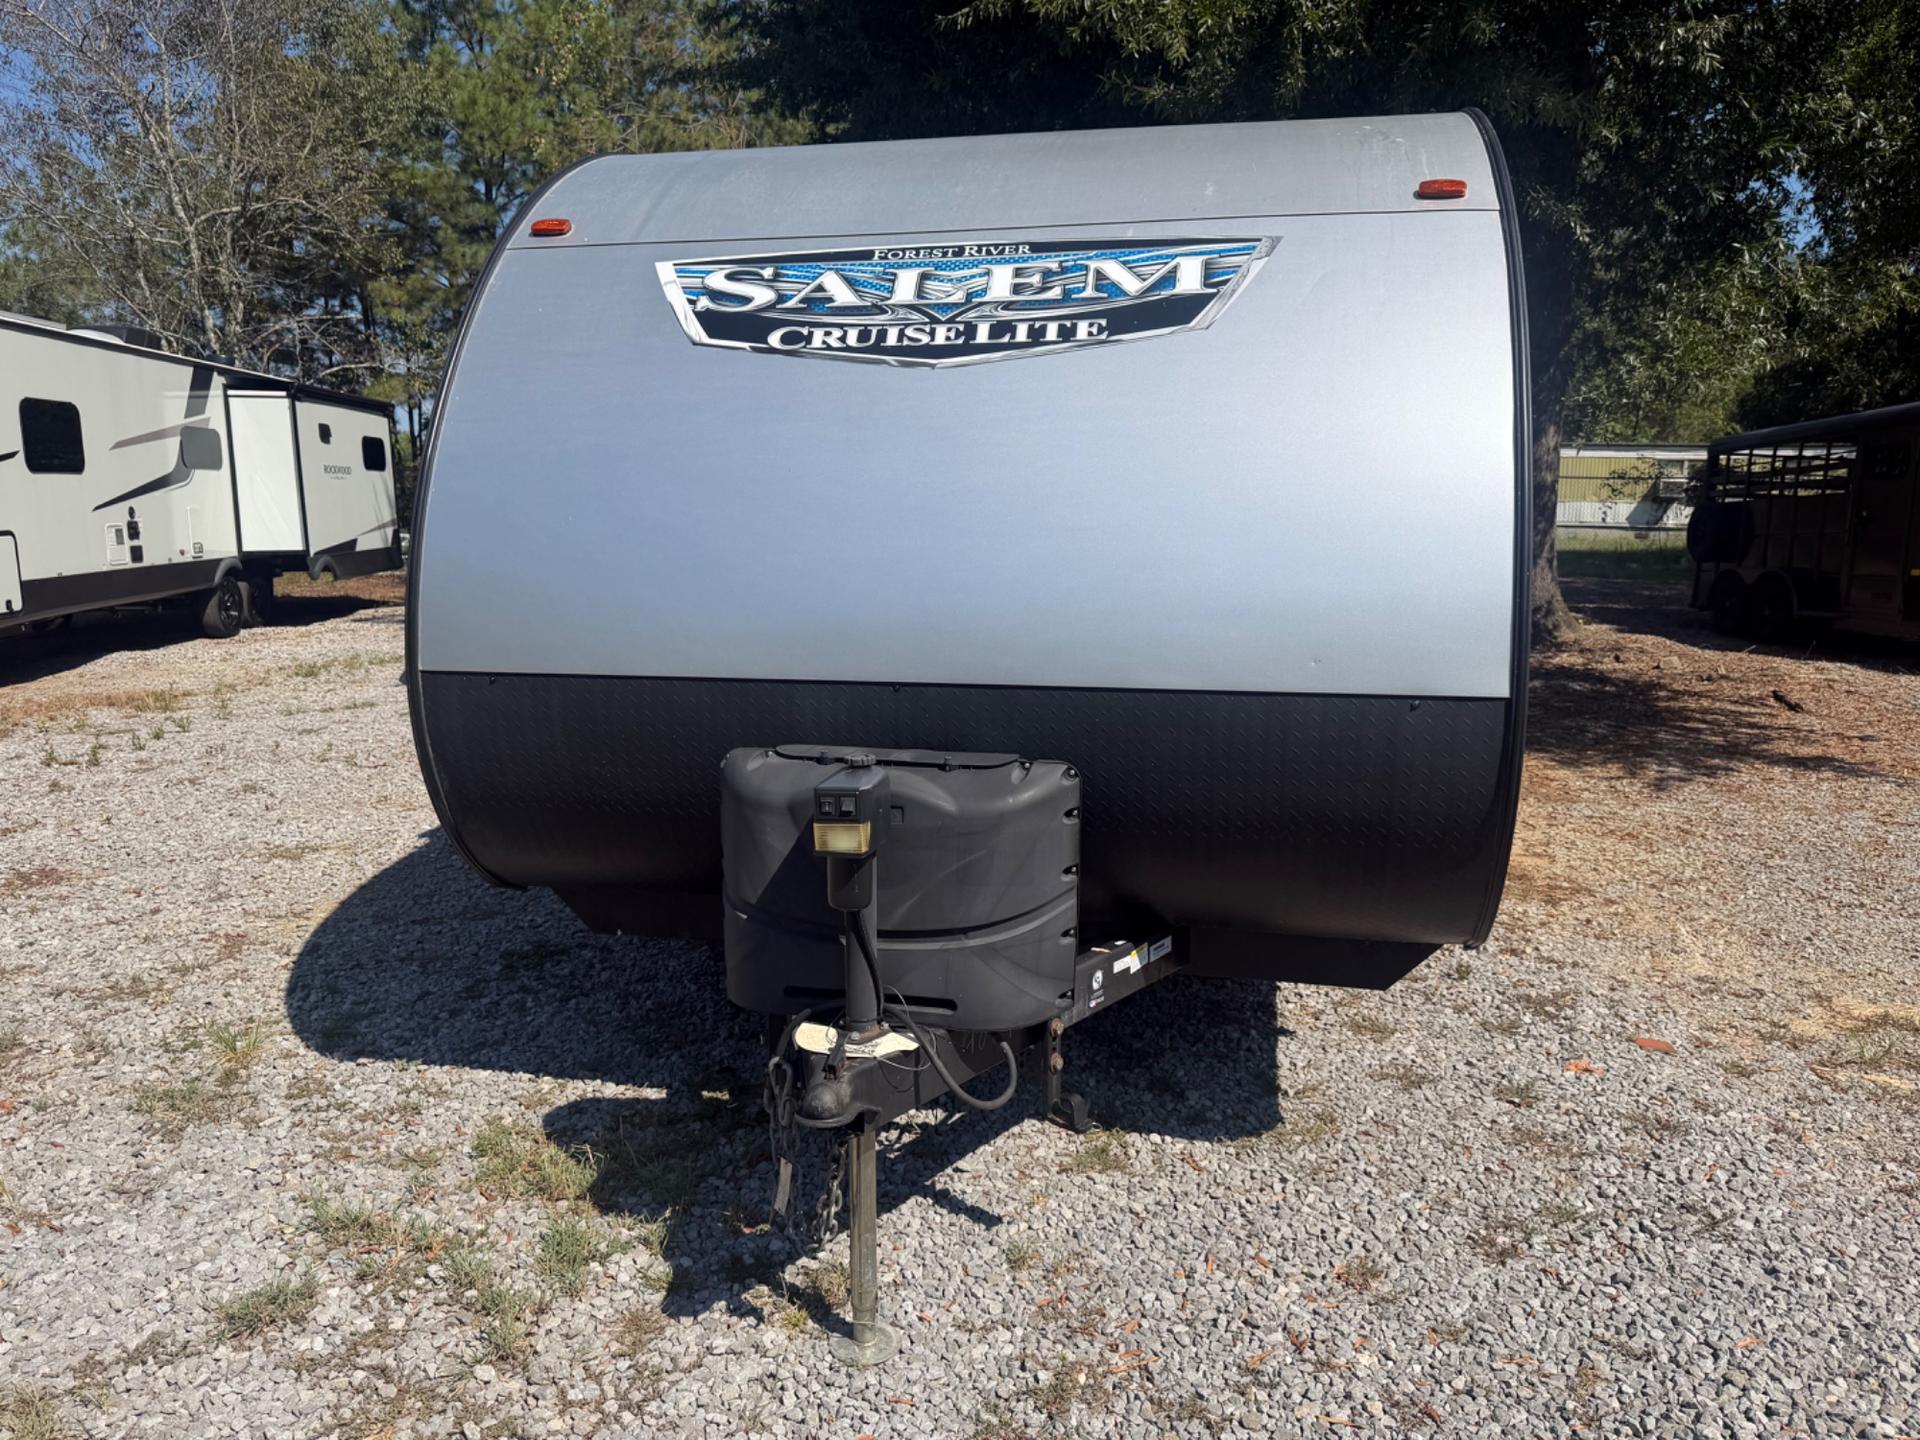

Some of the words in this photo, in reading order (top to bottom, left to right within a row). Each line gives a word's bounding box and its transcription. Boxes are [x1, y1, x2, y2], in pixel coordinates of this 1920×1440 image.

[872, 248, 959, 261] FOREST
[962, 244, 1031, 257] RIVER
[695, 255, 1222, 313] SALEM
